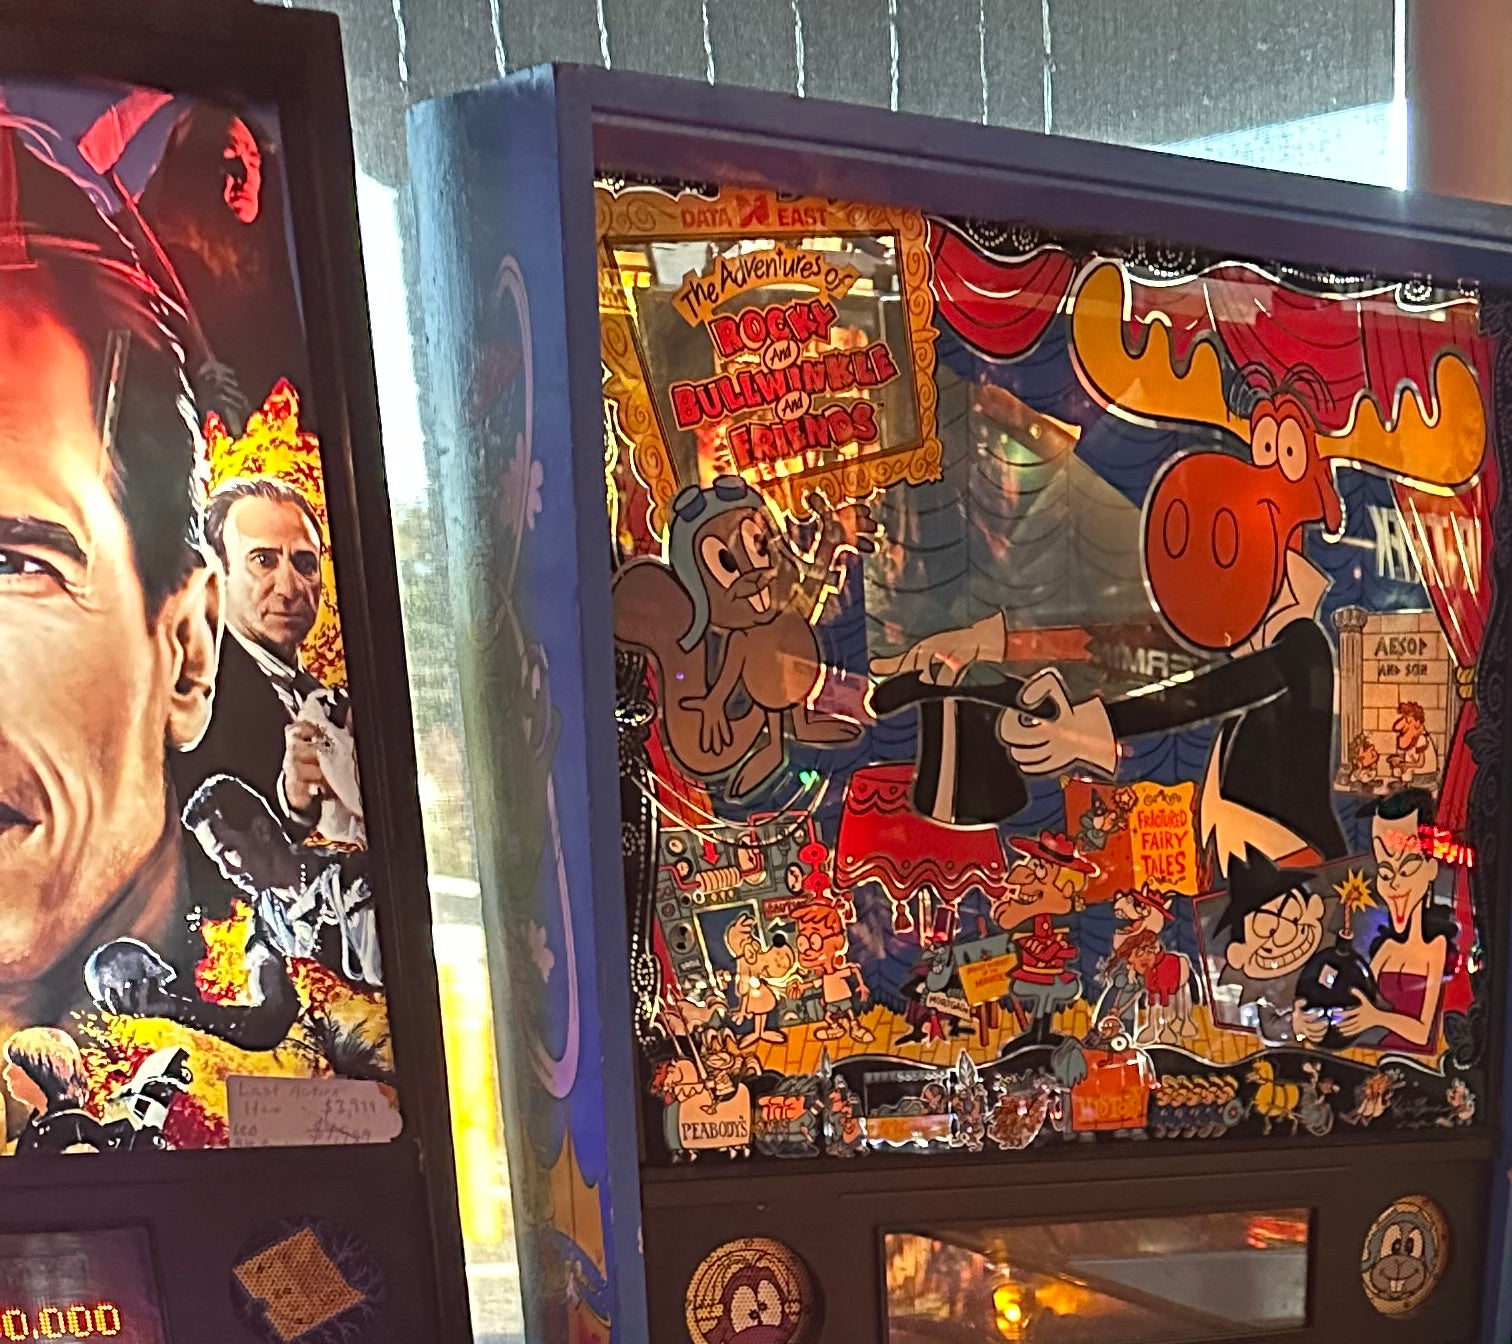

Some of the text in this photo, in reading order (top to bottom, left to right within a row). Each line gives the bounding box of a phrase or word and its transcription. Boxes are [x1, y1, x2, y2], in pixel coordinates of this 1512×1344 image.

[681, 206, 828, 228] DATA EAST
[681, 249, 855, 318] The Adventures of
[709, 301, 839, 358] ROCKY
[770, 344, 793, 365] And
[670, 343, 899, 429] BULLWINKLE
[783, 393, 804, 414] And
[728, 402, 878, 470] FRIENDS
[1375, 637, 1427, 657] AESOP
[1138, 810, 1187, 829] FRACTURED
[1142, 831, 1188, 850] FAIRY
[1141, 851, 1186, 876] TALES
[681, 1114, 748, 1140] PEABODY'S
